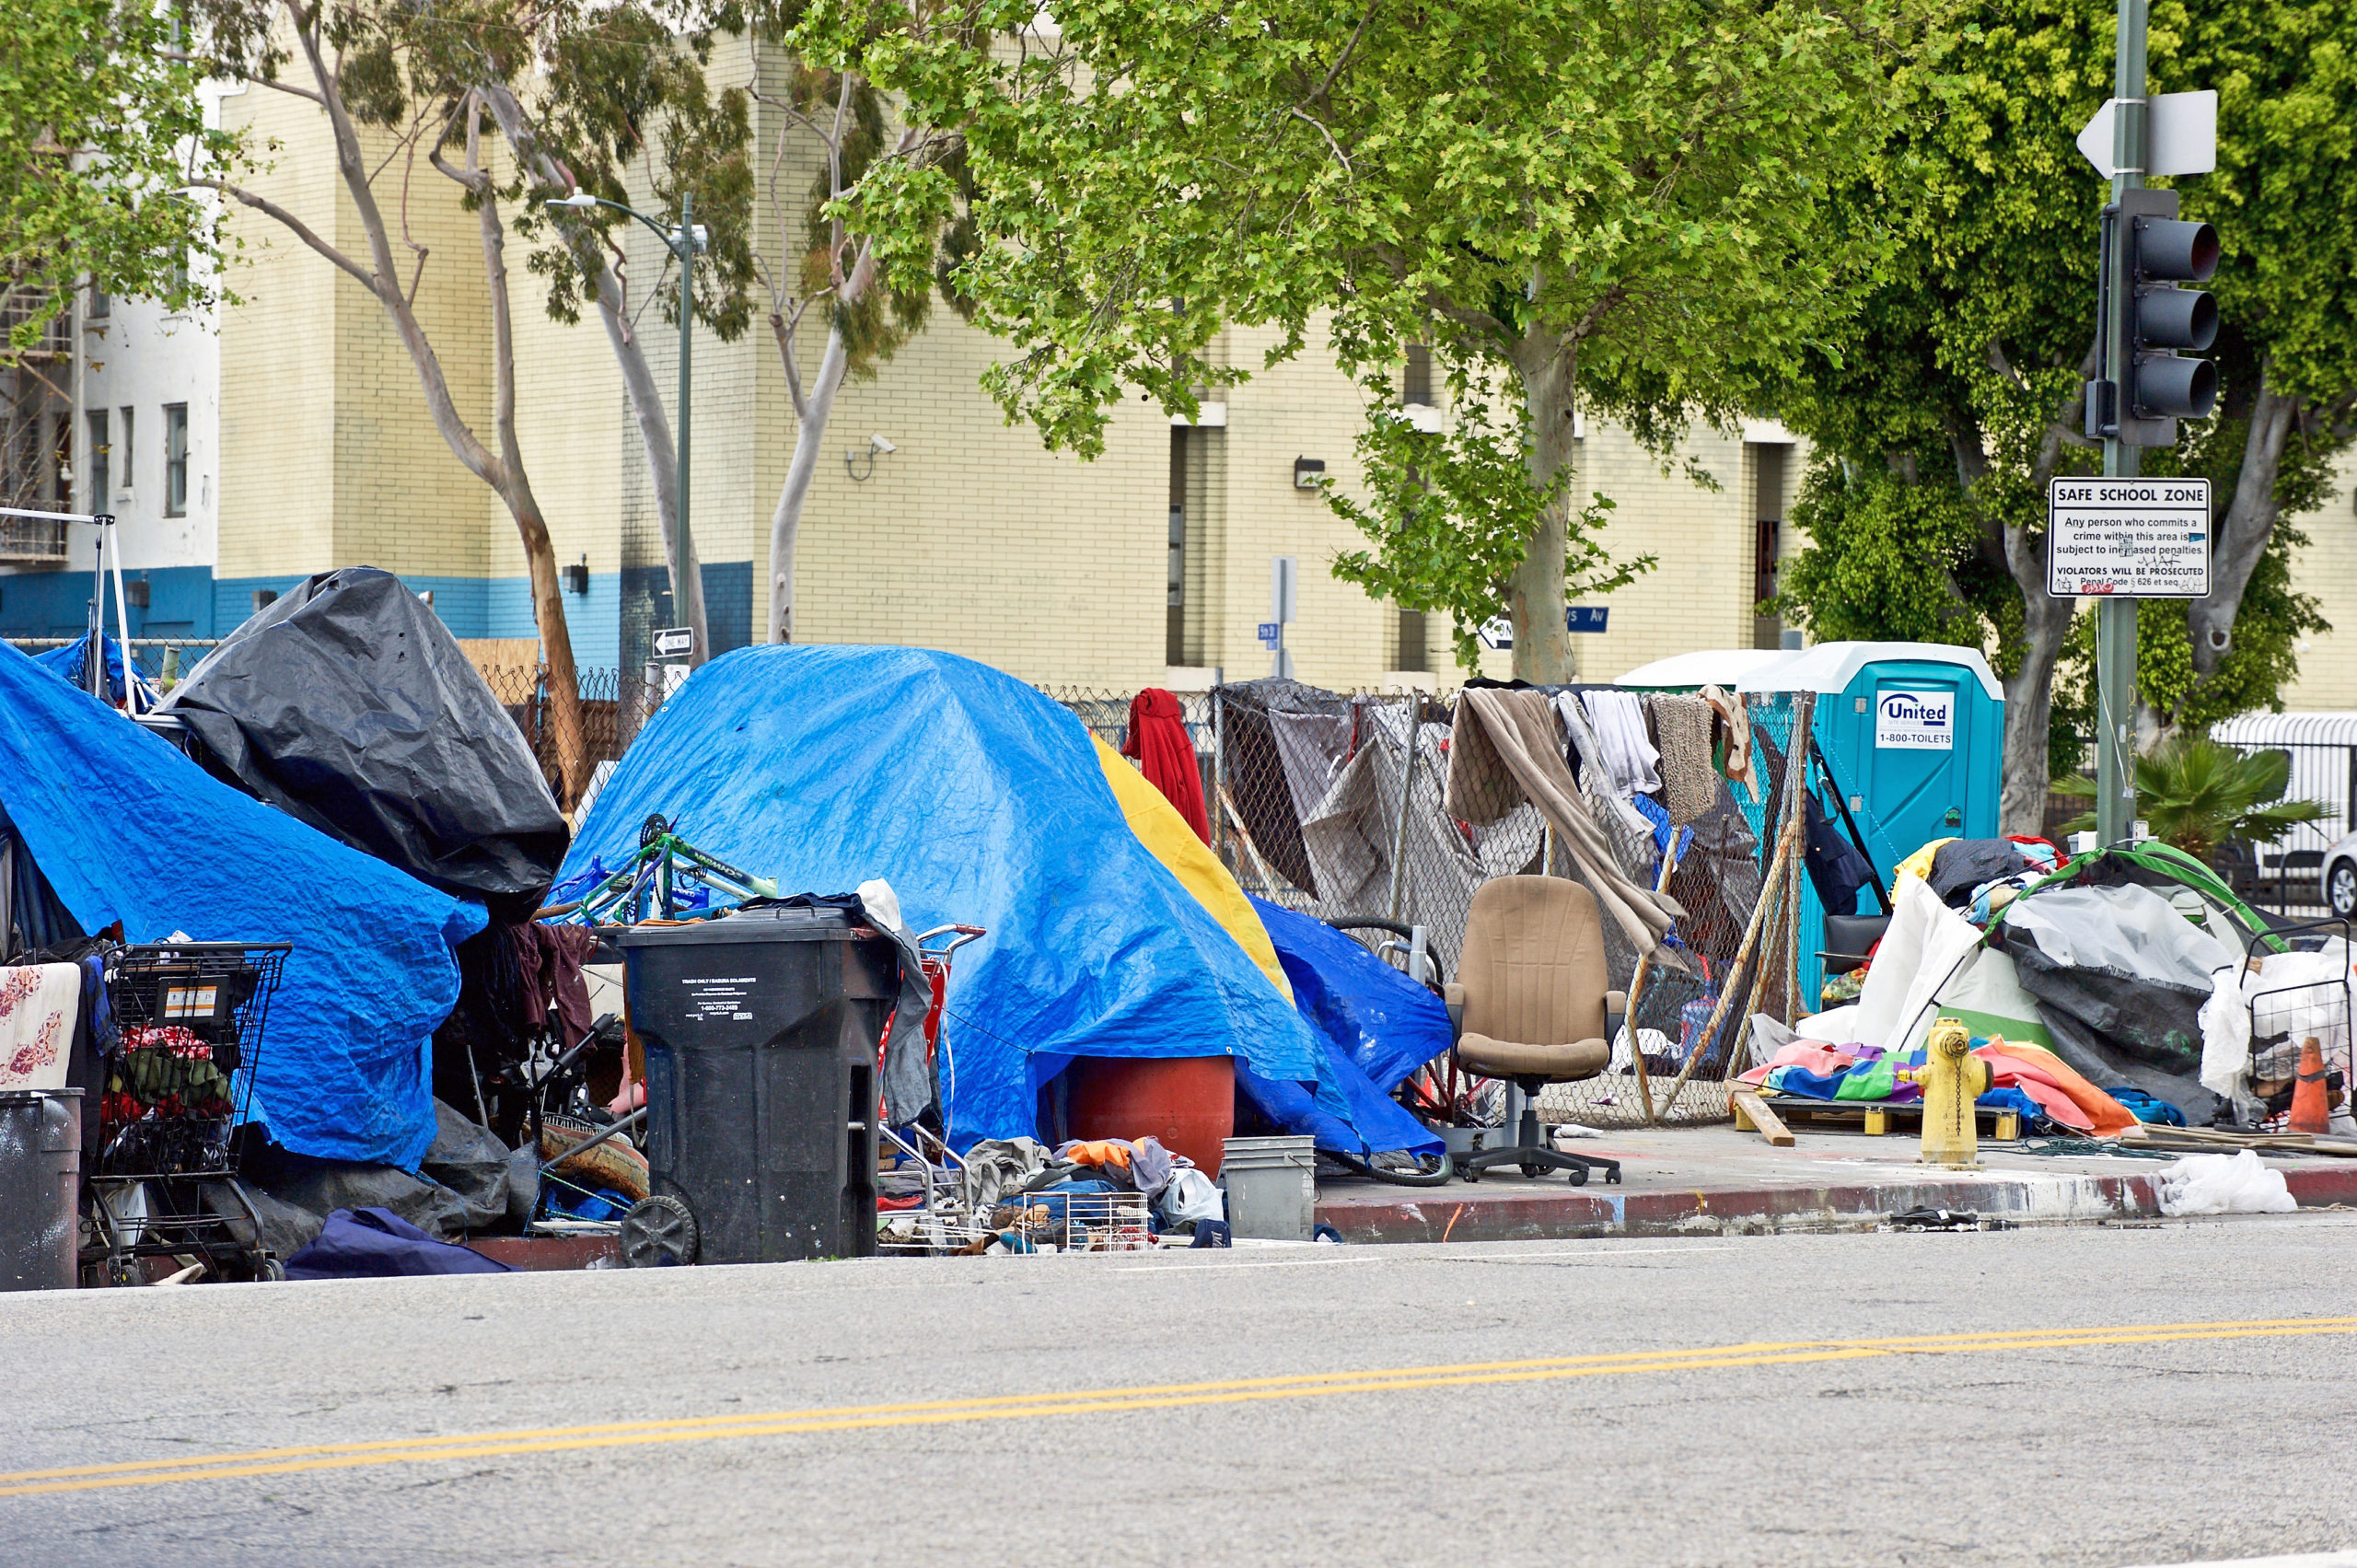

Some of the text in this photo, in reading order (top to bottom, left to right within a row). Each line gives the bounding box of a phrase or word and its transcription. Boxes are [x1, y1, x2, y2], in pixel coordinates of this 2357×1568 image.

[2058, 488, 2203, 501] SAFE SCHOOL ZONE
[2064, 517, 2084, 528] Any
[2088, 519, 2121, 528] person
[2125, 518, 2144, 527] who
[2147, 518, 2189, 527] commits
[2073, 532, 2101, 540] crime
[2105, 531, 2133, 540] within
[2136, 532, 2154, 540] this
[2180, 532, 2188, 540] is
[2057, 545, 2094, 555] subject
[2096, 545, 2107, 554] to
[2109, 545, 2155, 554] inased
[2159, 546, 2204, 556] penalties.
[2057, 567, 2204, 575] VIOLATORS WILL BE PROSECUTED
[2081, 577, 2104, 586] Penal
[2107, 577, 2128, 586] Code
[2137, 577, 2152, 586] 626
[1590, 609, 1604, 622] Av
[665, 636, 688, 648] ONE WAY
[1888, 703, 1946, 720] United
[1880, 734, 1951, 743] 1-800-TOILETS
